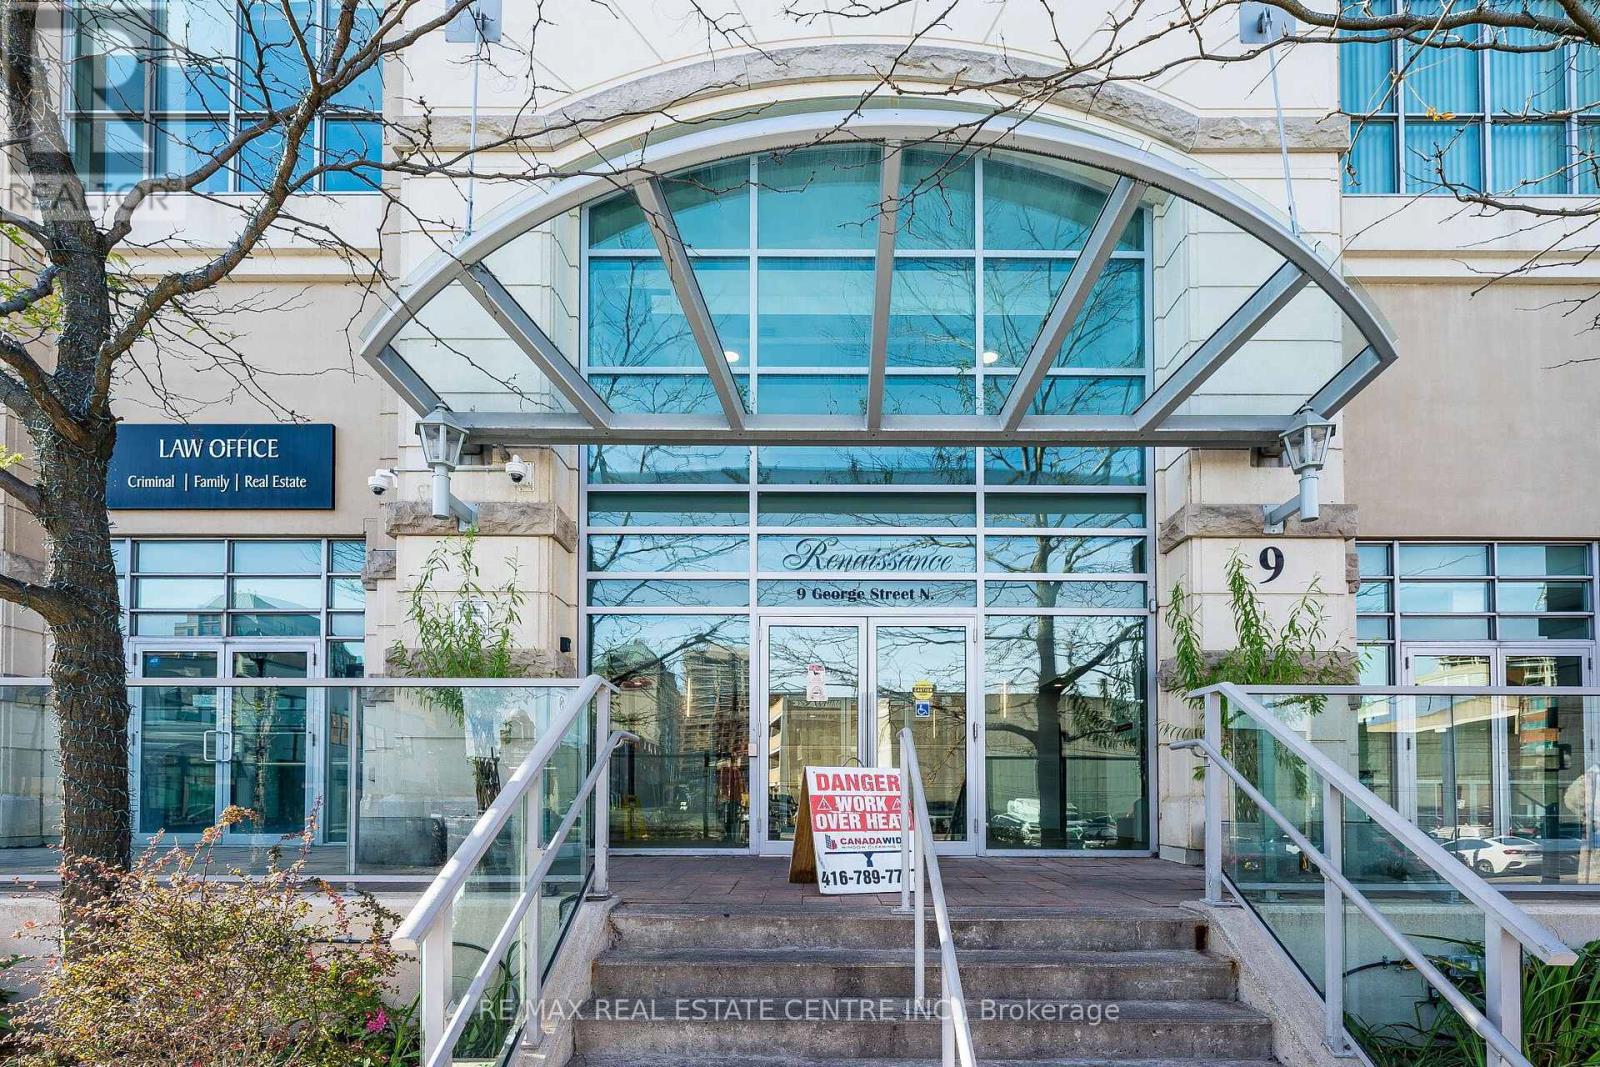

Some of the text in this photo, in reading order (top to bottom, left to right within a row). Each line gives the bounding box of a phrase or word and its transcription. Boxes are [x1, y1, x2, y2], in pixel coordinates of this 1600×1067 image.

[159, 438, 279, 459] LAW OFFICE
[127, 474, 307, 493] Criminal Family Real Estate
[782, 536, 954, 572] Renaissance
[1259, 546, 1285, 584] 9
[796, 587, 934, 603] 9 George Street N.
[815, 773, 901, 792] DANGER
[835, 795, 888, 812] WORK
[815, 812, 911, 830] OVER HEA
[840, 836, 902, 845] CANADAWID
[821, 868, 914, 887] 416-789-77
